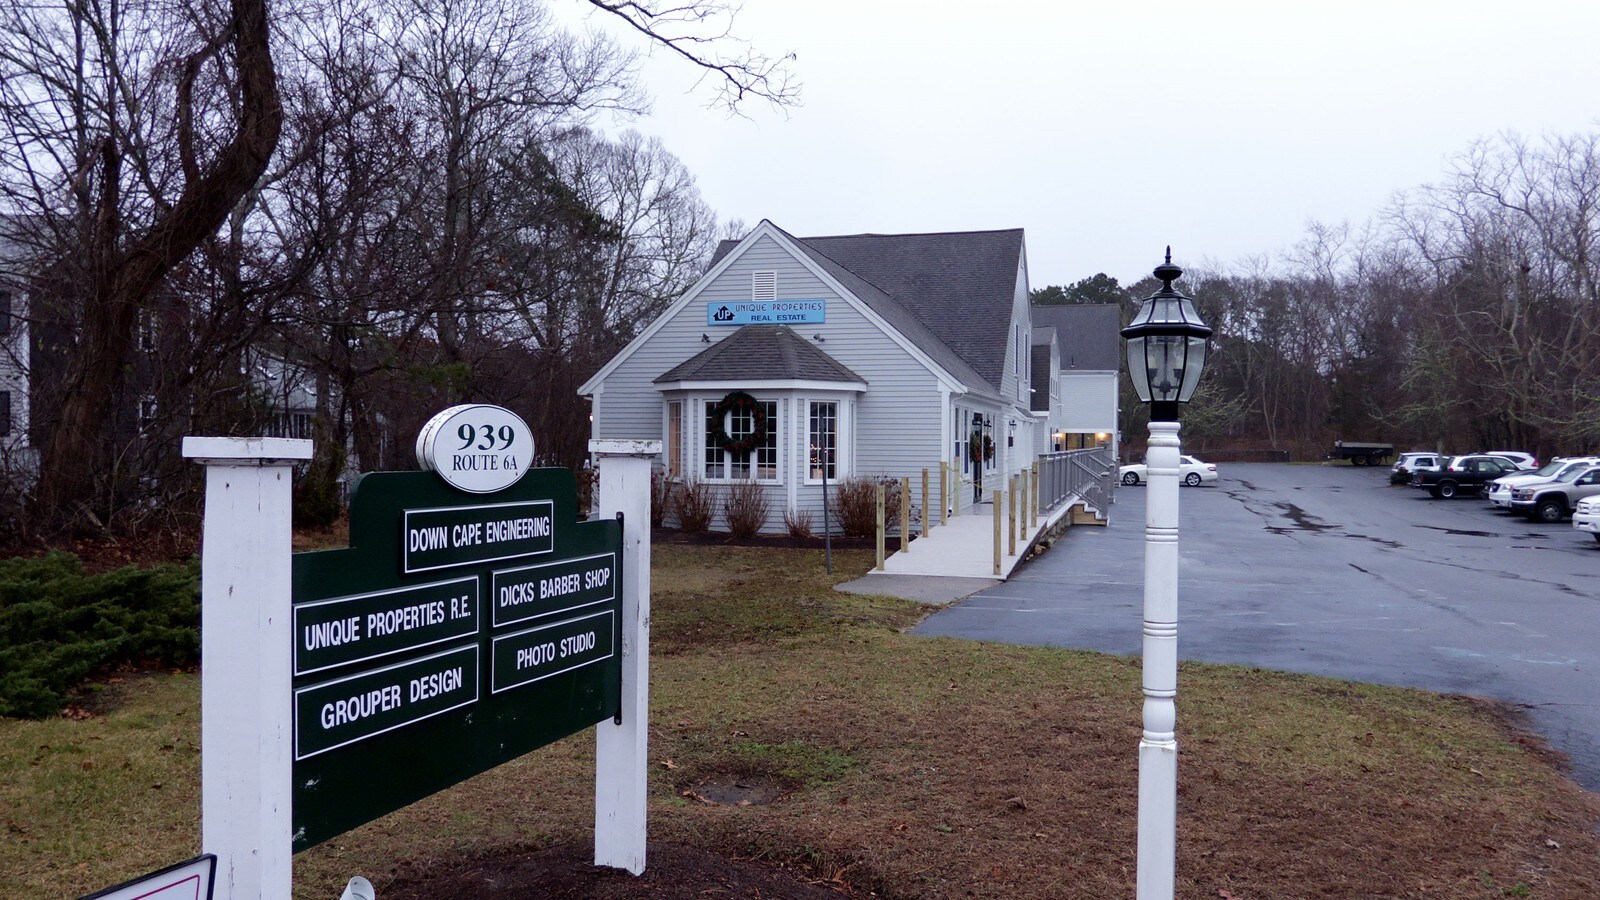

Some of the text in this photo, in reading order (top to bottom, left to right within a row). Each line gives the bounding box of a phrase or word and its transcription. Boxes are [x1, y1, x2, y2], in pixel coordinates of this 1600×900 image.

[735, 302, 822, 312] UNIQUE PROPERTIES
[457, 423, 515, 450] 939
[452, 454, 518, 471] ROUTE 6A
[410, 516, 550, 552] DOWN CAPE ENGINEERING
[500, 567, 610, 608] DICKS BARBER SHOP
[304, 595, 471, 651] UNIQUE PROPERTIES R.E.
[516, 631, 596, 670] PHOTO STUDIO
[320, 666, 462, 730] GROUPER DESIGN
